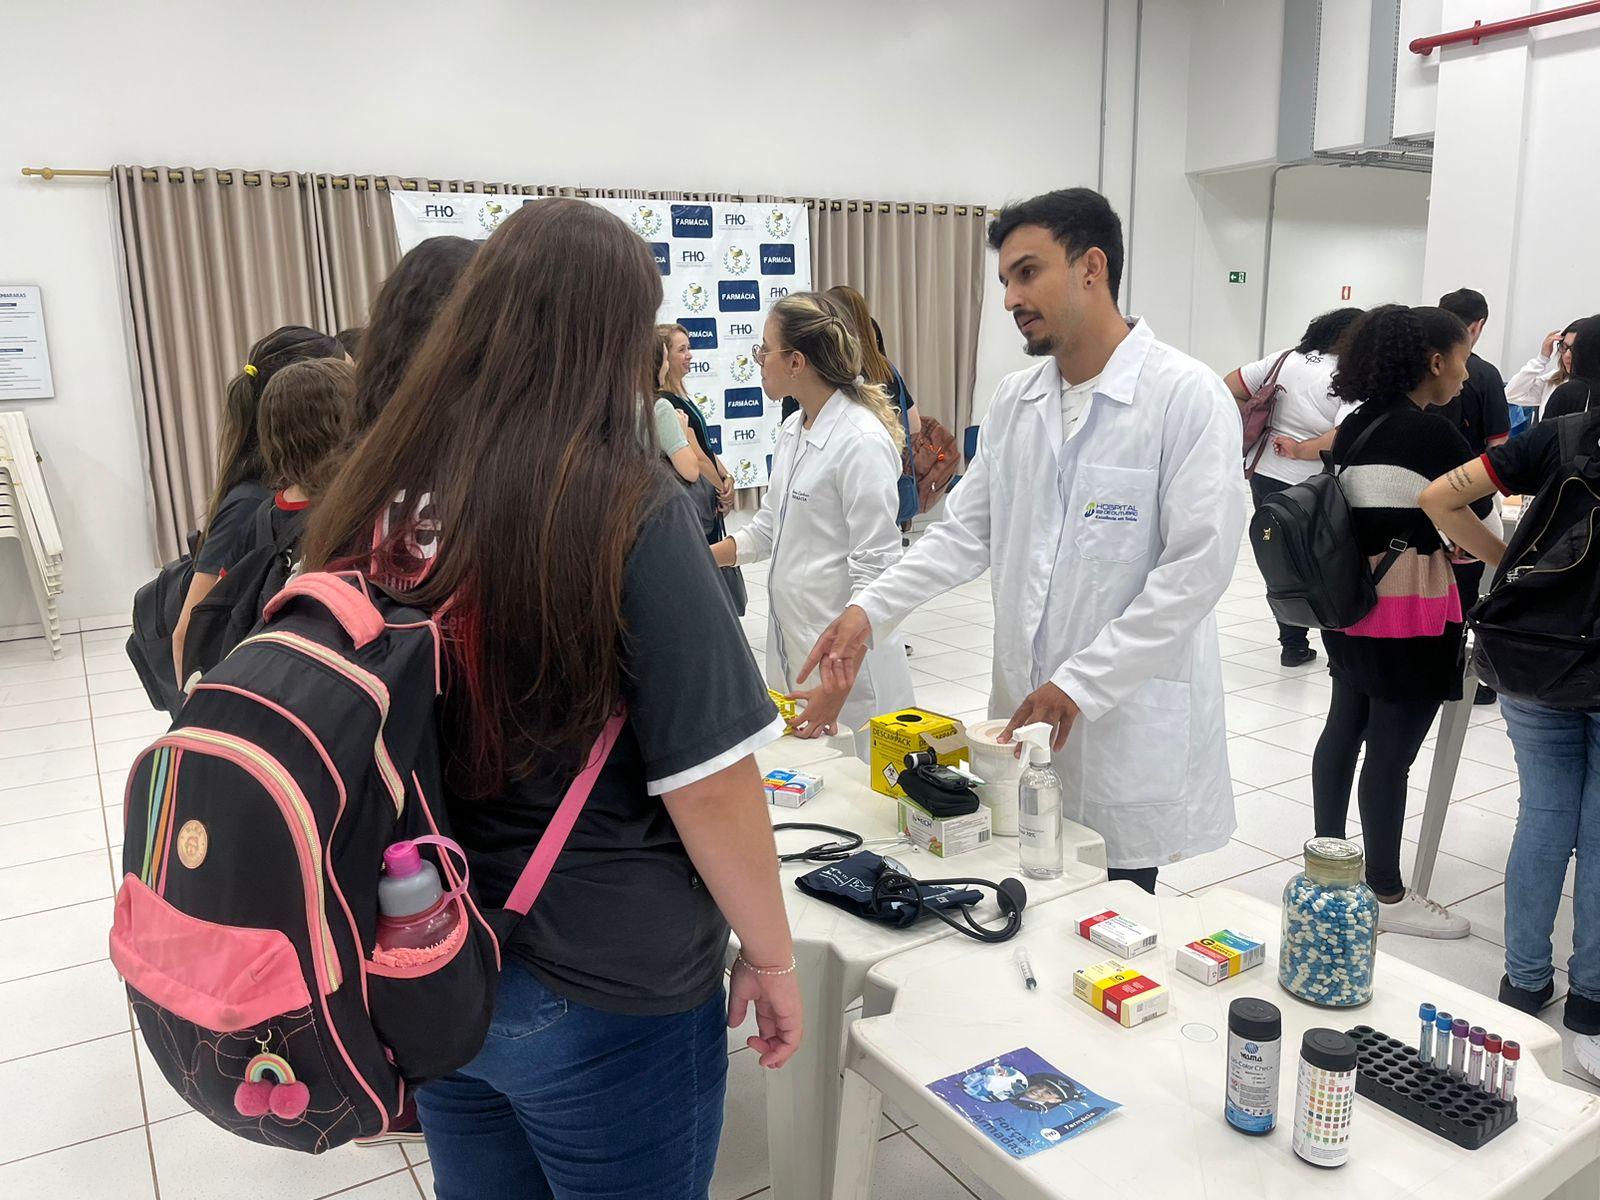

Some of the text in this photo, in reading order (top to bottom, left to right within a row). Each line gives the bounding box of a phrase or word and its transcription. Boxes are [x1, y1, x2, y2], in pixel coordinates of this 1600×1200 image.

[425, 205, 454, 218] FHO
[675, 216, 709, 226] FARMÁCIA
[725, 214, 746, 225] FHO
[682, 251, 705, 262] FHO
[763, 255, 792, 264] FARMÁCIA
[770, 287, 788, 298] FHO
[730, 324, 752, 335] FHO
[688, 362, 710, 373] FHO
[727, 399, 760, 408] FARMÁCIA
[734, 429, 756, 440] FHO
[1096, 503, 1138, 511] HOSPITAL
[1240, 1051, 1263, 1063] WAMA
[970, 1115, 1025, 1155] Armadas
